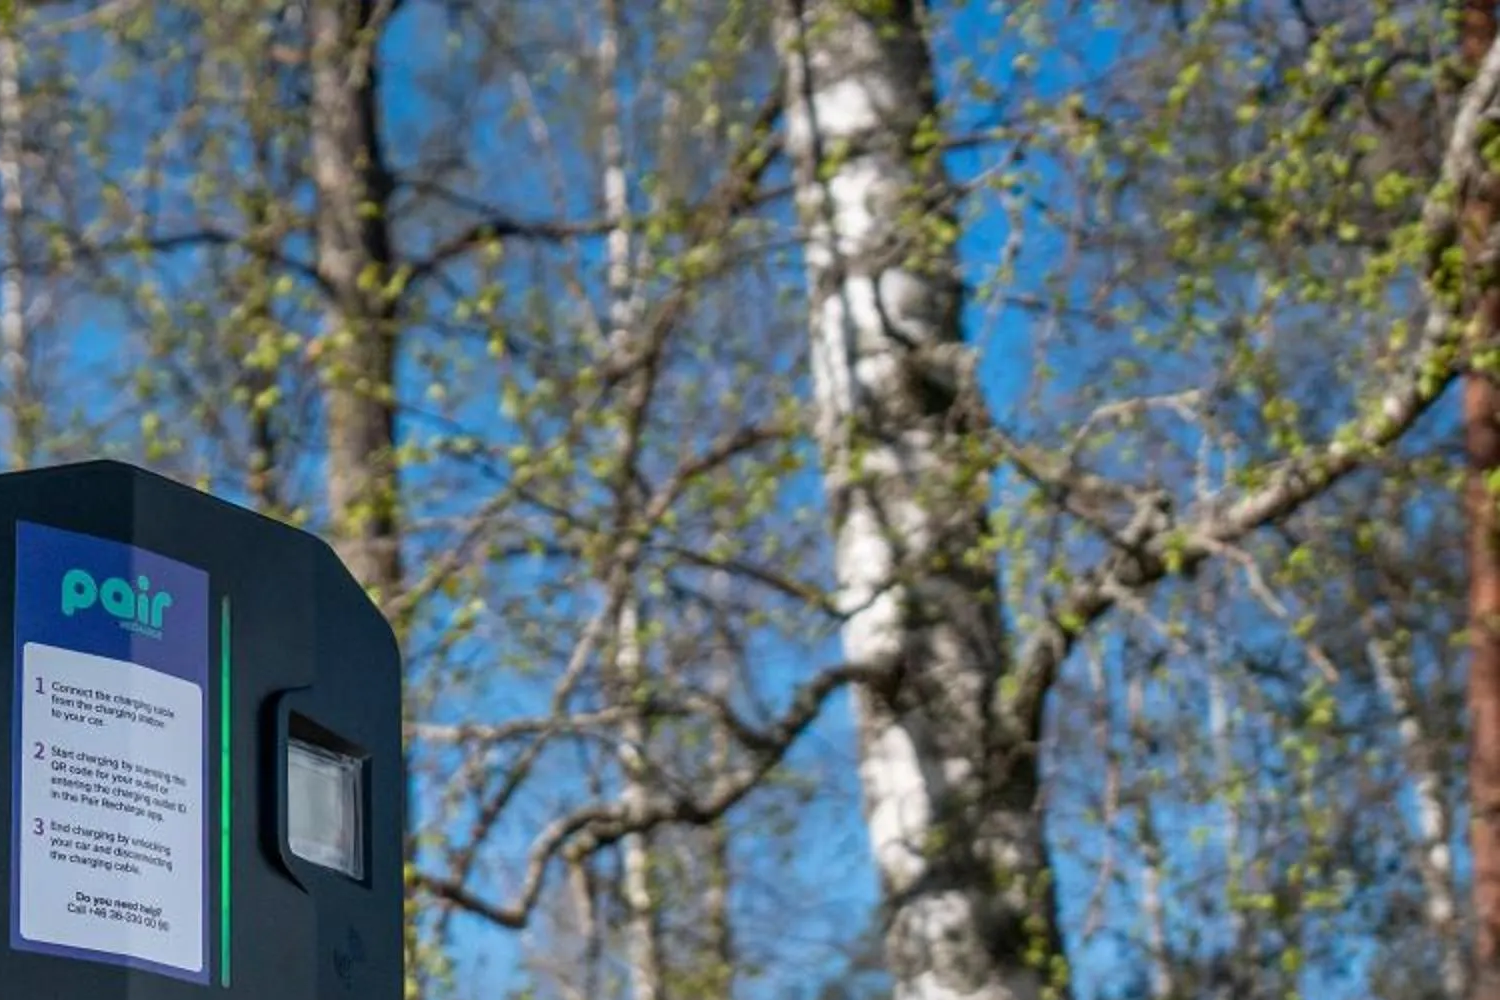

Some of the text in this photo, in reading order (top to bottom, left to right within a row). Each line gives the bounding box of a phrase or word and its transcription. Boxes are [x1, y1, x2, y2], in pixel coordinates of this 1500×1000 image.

[61, 569, 173, 630] pair
[35, 677, 175, 718] 1 Connect the charging cable
[51, 694, 74, 707] from
[76, 698, 93, 710] the
[95, 703, 136, 722] charging
[51, 708, 61, 718] to
[63, 711, 85, 723] your
[33, 741, 45, 760] 2
[51, 745, 74, 758] Start
[76, 751, 119, 769] charging
[121, 759, 132, 772] by
[135, 764, 171, 784] scanning
[51, 759, 169, 795] QR code for your outlet or
[51, 776, 187, 813] entering the charging outlet ID
[62, 791, 78, 802] the
[81, 794, 99, 806] Pair
[101, 799, 145, 817] Recharge
[33, 817, 171, 856] 3 End charging by unlocking
[50, 837, 173, 872] your car and disconnecting
[50, 850, 67, 861] the
[69, 854, 112, 871] charging
[67, 902, 87, 914] Call
[75, 891, 163, 918] Do you need help?
